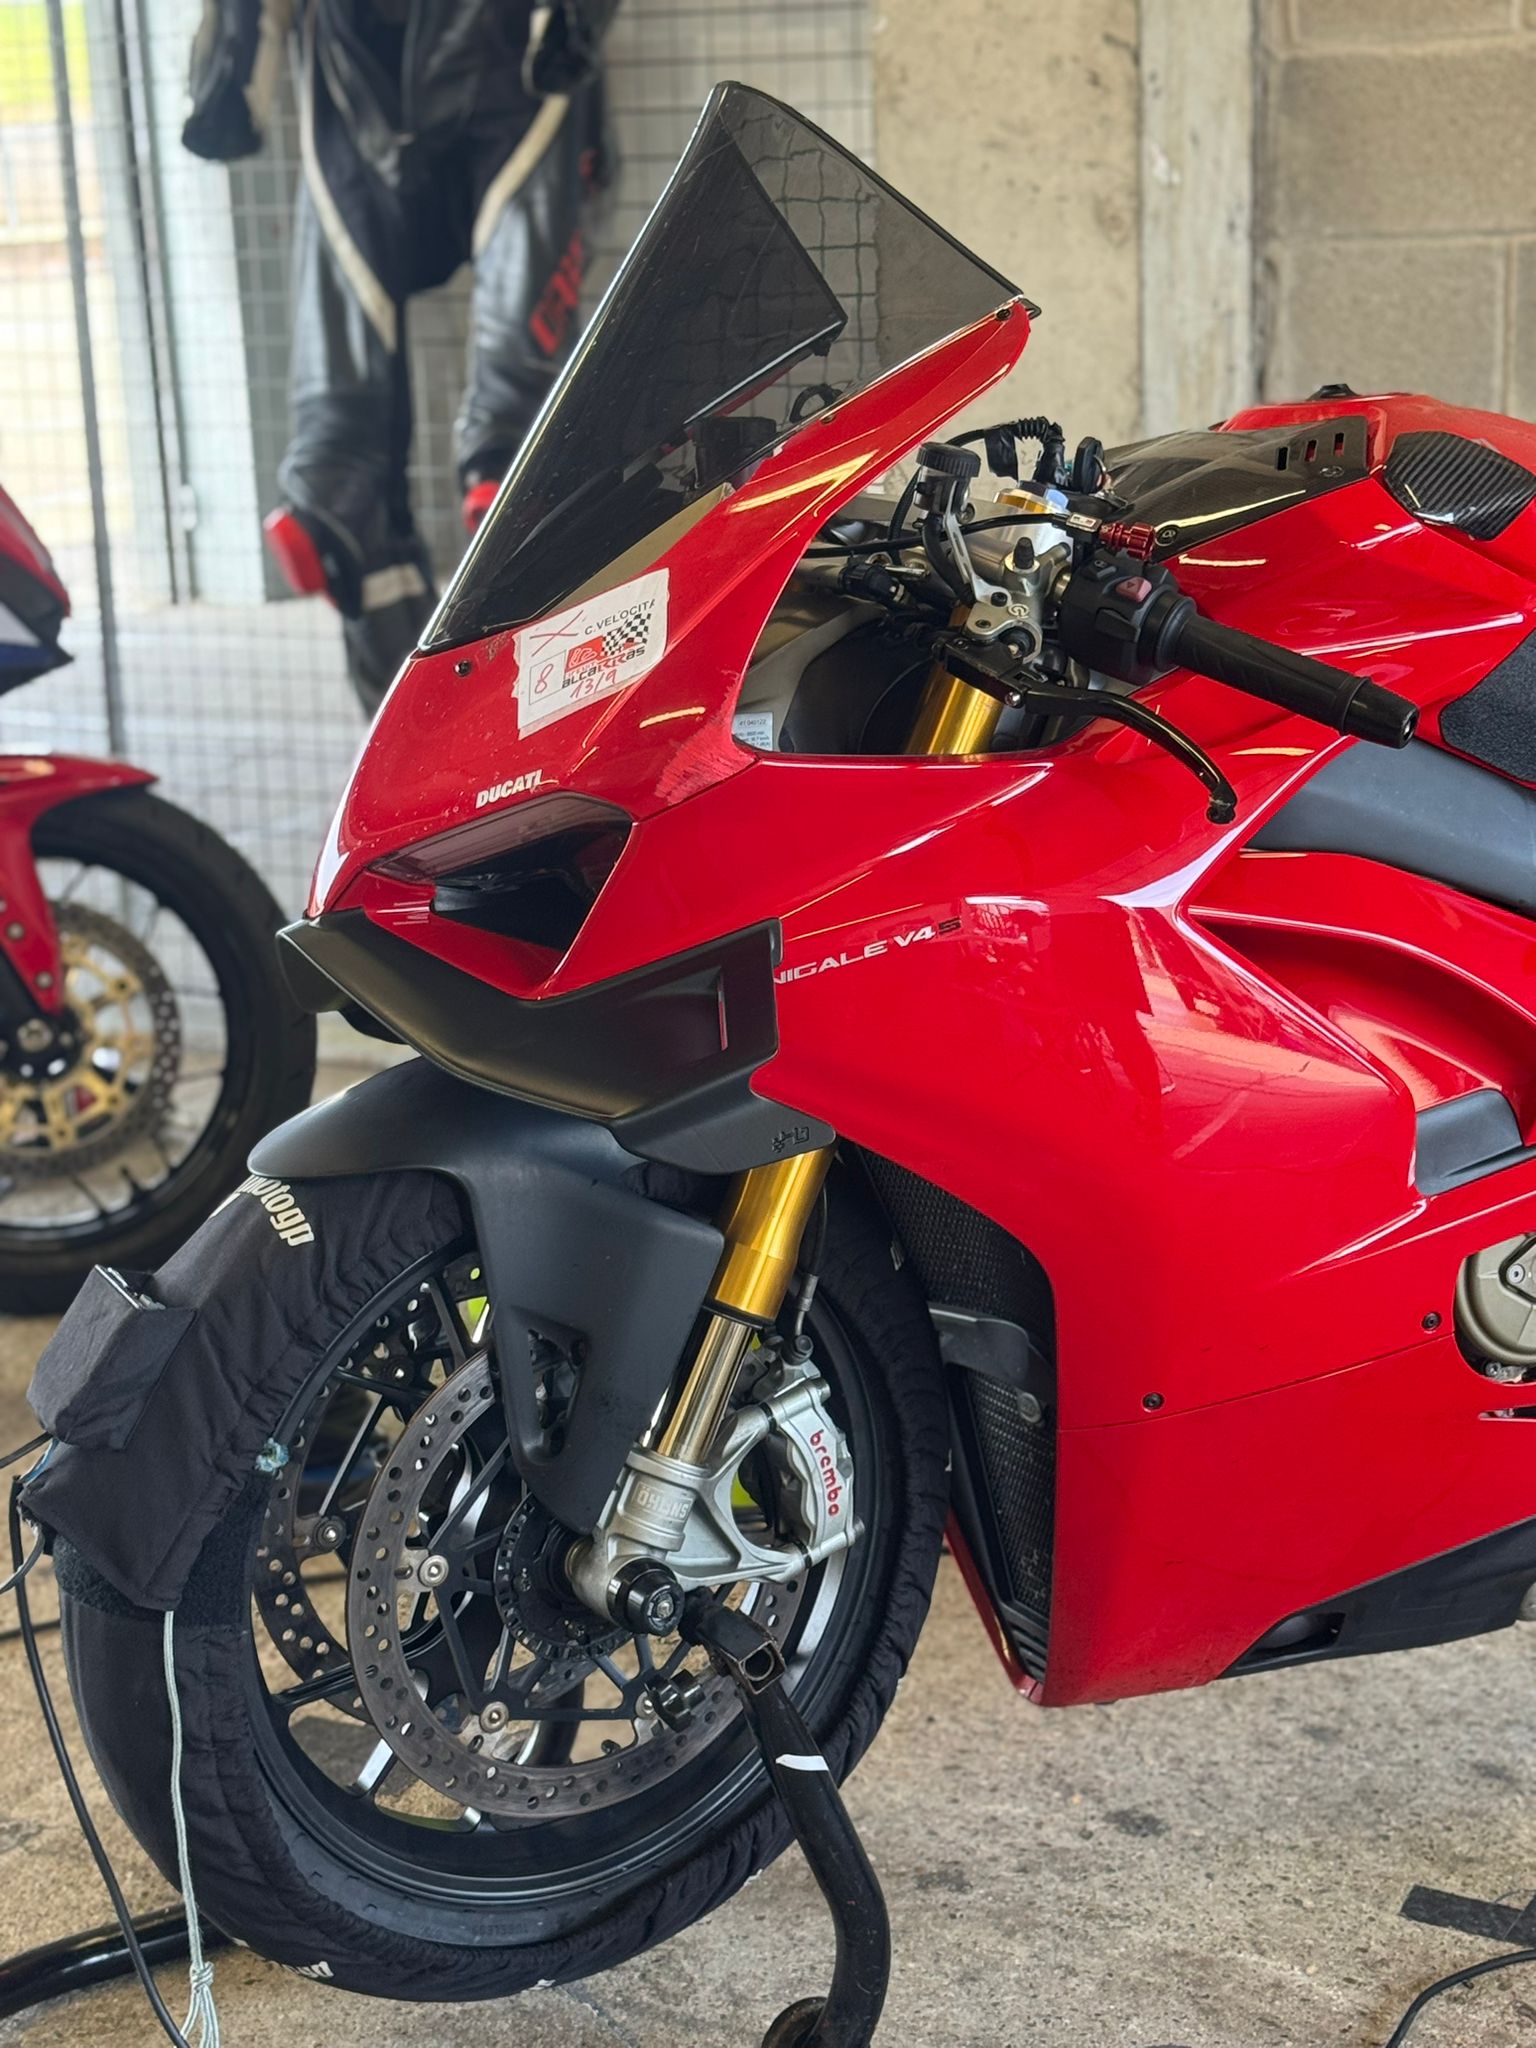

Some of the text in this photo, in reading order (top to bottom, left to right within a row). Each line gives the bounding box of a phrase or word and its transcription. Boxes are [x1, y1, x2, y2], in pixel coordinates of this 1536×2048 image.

[534, 663, 554, 694] 8
[475, 769, 543, 809] DUCATI
[809, 1428, 842, 1517] brembo
